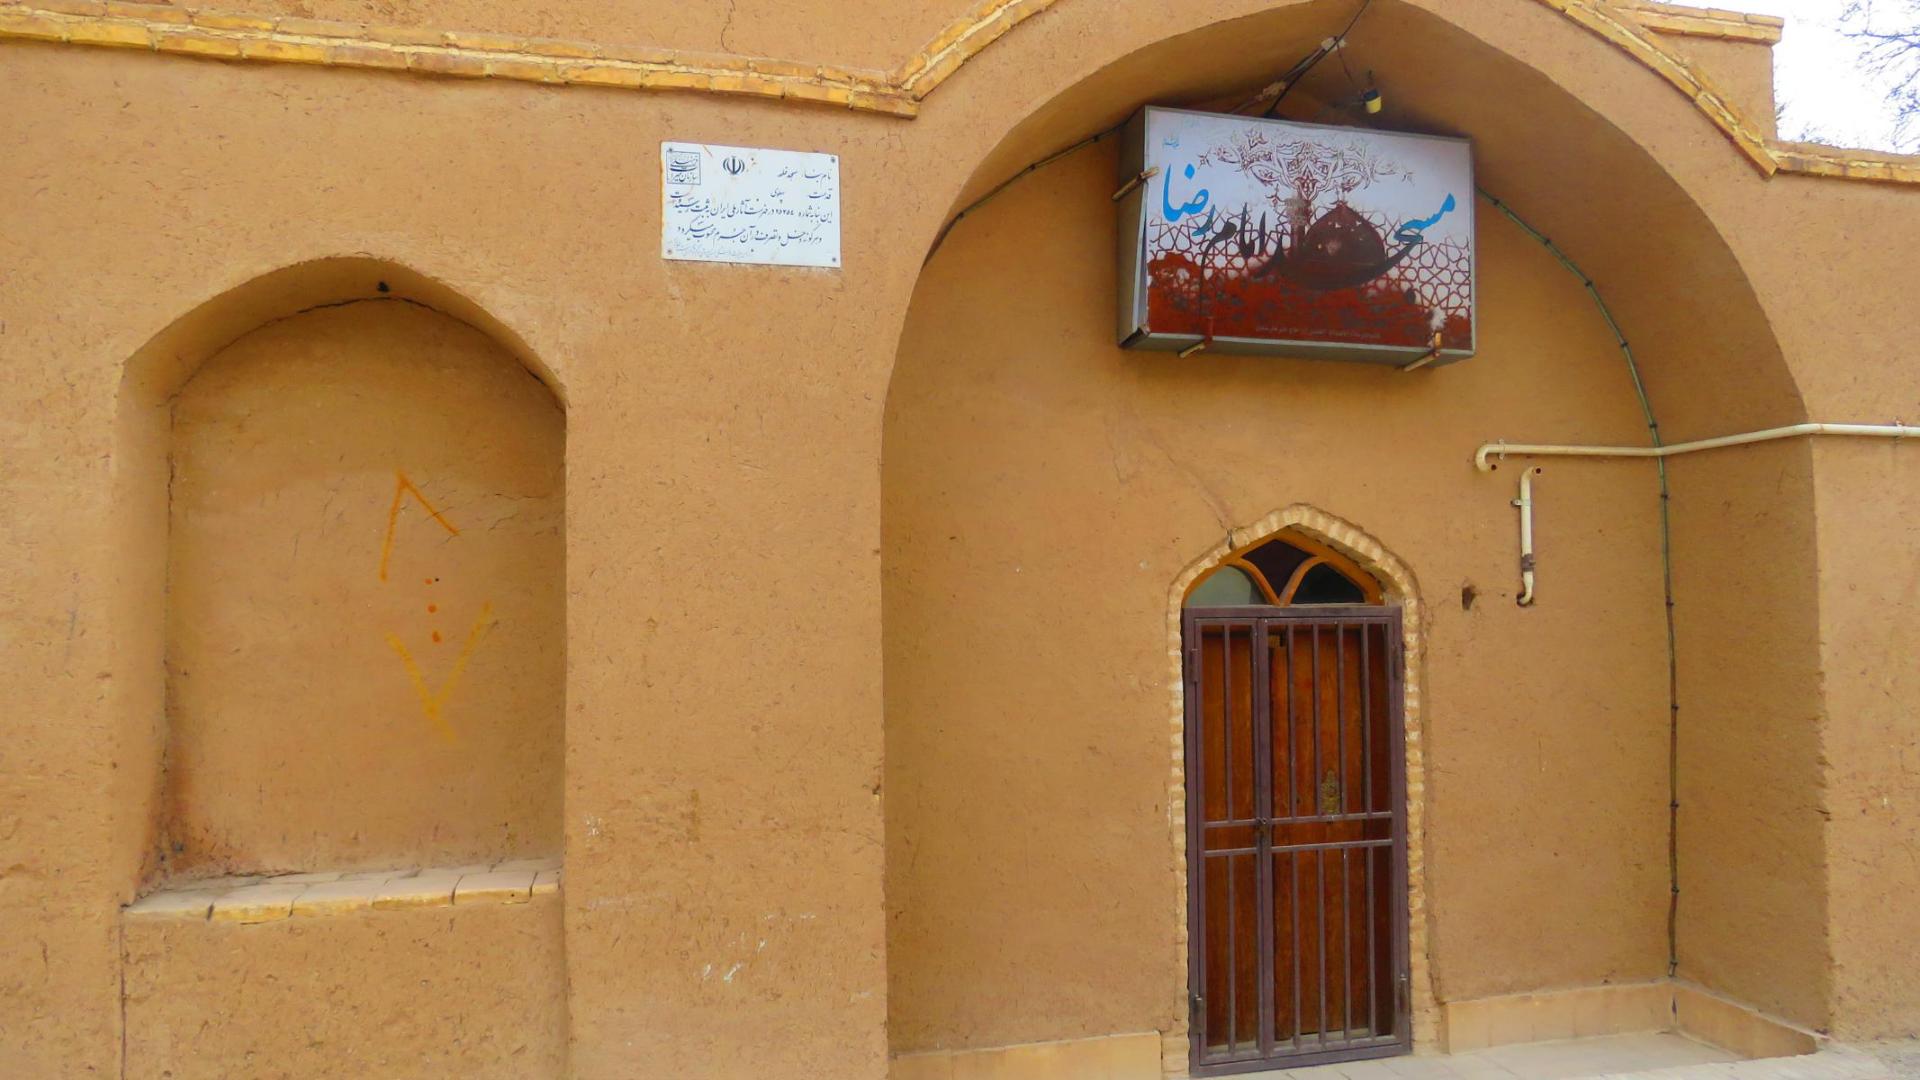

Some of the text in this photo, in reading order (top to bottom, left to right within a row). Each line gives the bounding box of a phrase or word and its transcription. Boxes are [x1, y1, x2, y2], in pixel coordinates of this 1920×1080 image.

[820, 168, 832, 189] نام
[1163, 164, 1215, 237] رضا
[820, 210, 833, 223] این
